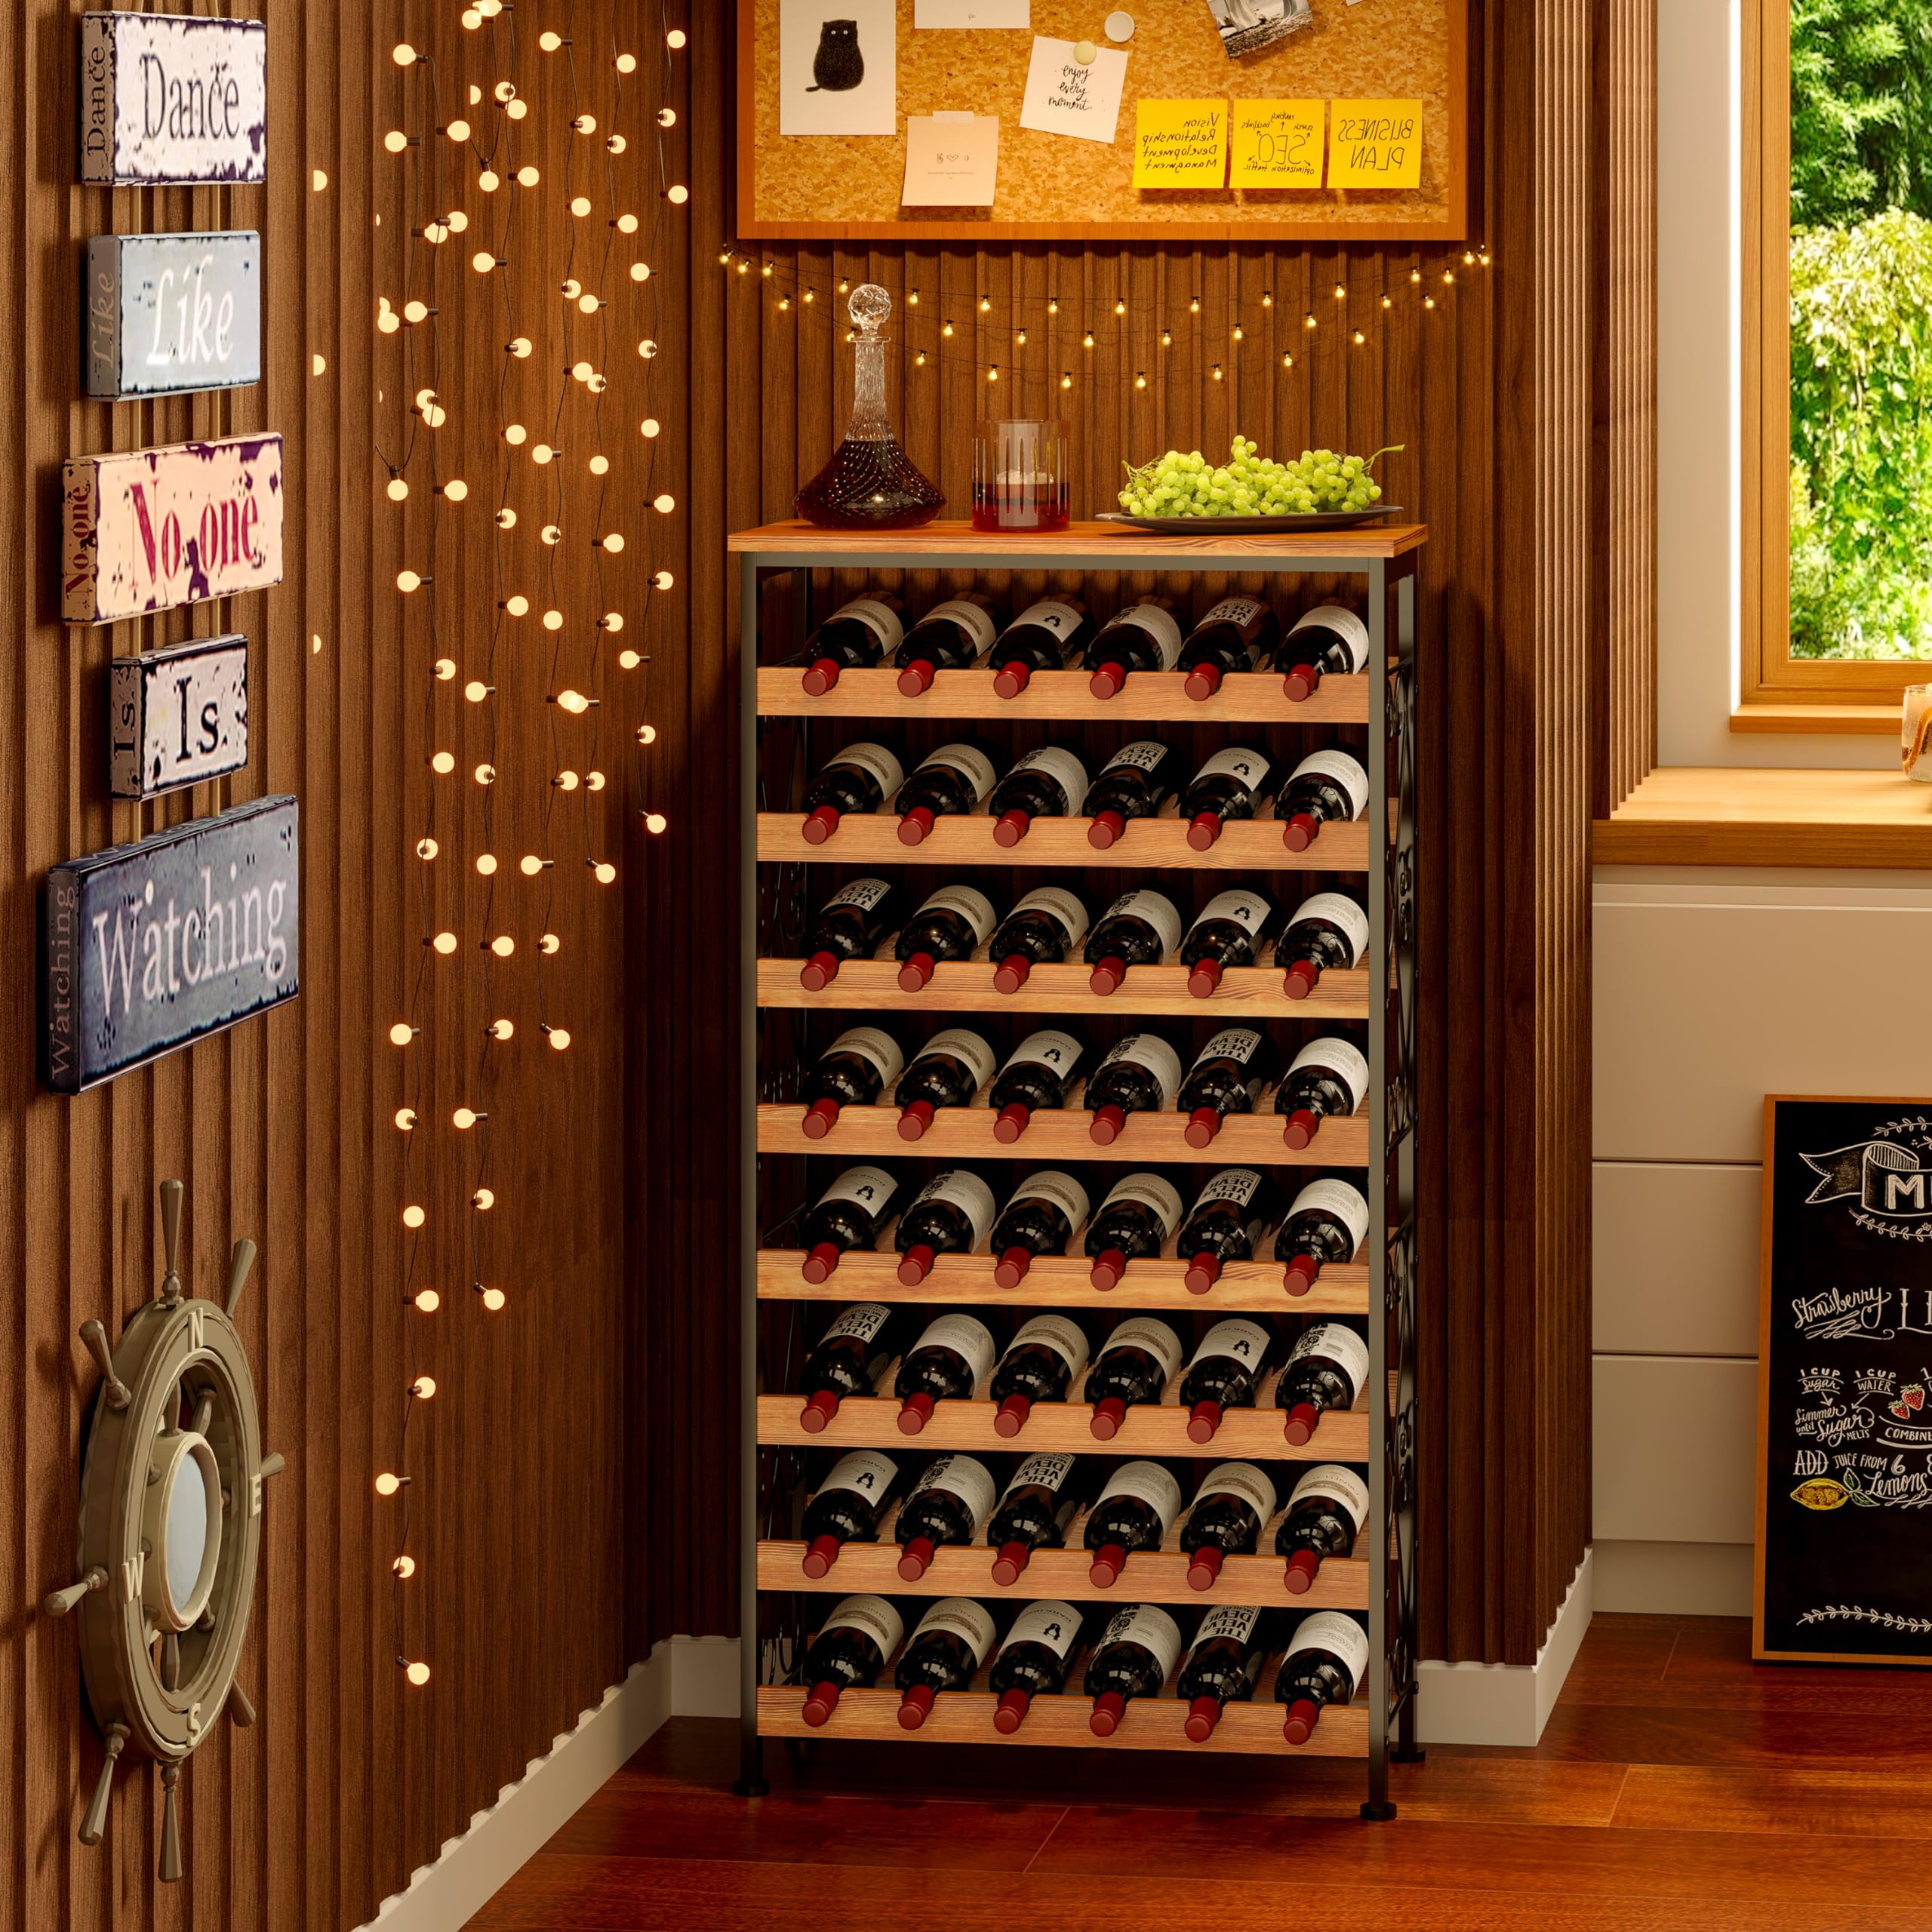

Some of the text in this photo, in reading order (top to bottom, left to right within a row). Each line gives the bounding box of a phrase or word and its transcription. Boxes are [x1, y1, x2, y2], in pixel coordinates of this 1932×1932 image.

[1057, 82, 1090, 101] every
[1061, 65, 1094, 85] enjoy
[86, 46, 106, 155] Dance
[140, 54, 240, 140] Dance
[1048, 96, 1092, 110] moment
[91, 270, 115, 370] Like
[146, 254, 233, 367] Like
[65, 485, 90, 594] No one
[130, 478, 258, 589] No one
[176, 675, 219, 763] Is
[92, 863, 287, 1016] Watching
[51, 884, 76, 1081] Watching
[1884, 1174, 1932, 1209] M
[1792, 1287, 1892, 1329] Strawberry
[187, 1306, 204, 1352] N
[1801, 1379, 1841, 1392] Sugar
[1810, 1367, 1841, 1377] CUP
[1857, 1380, 1891, 1392] WATER
[1866, 1368, 1897, 1379] CUP
[1795, 1404, 1847, 1425] Simmer
[1796, 1407, 1875, 1447] until Sugar MELTS
[1792, 1450, 1829, 1475] ADD
[1832, 1453, 1857, 1469] JUICE
[1860, 1454, 1887, 1471] FROM
[1890, 1454, 1906, 1475] 6
[1863, 1471, 1927, 1496] Lemons
